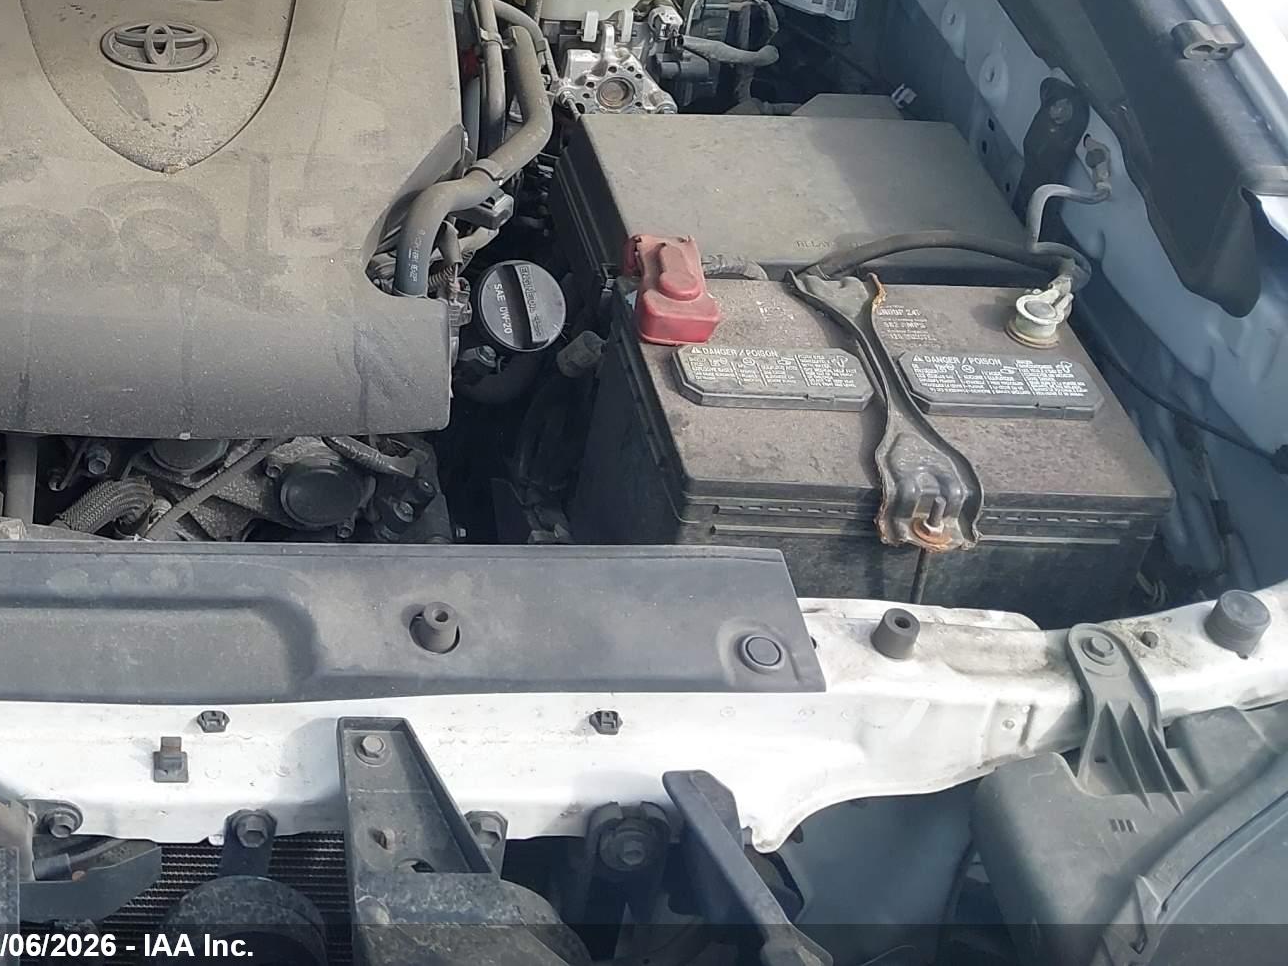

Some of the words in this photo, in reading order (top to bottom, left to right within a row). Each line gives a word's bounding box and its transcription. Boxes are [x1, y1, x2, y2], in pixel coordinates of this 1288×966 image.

[493, 283, 506, 303] SAE
[701, 347, 738, 356] DANGER
[745, 349, 779, 358] POISON
[923, 355, 961, 365] DANGER
[968, 357, 1002, 366] POISON
